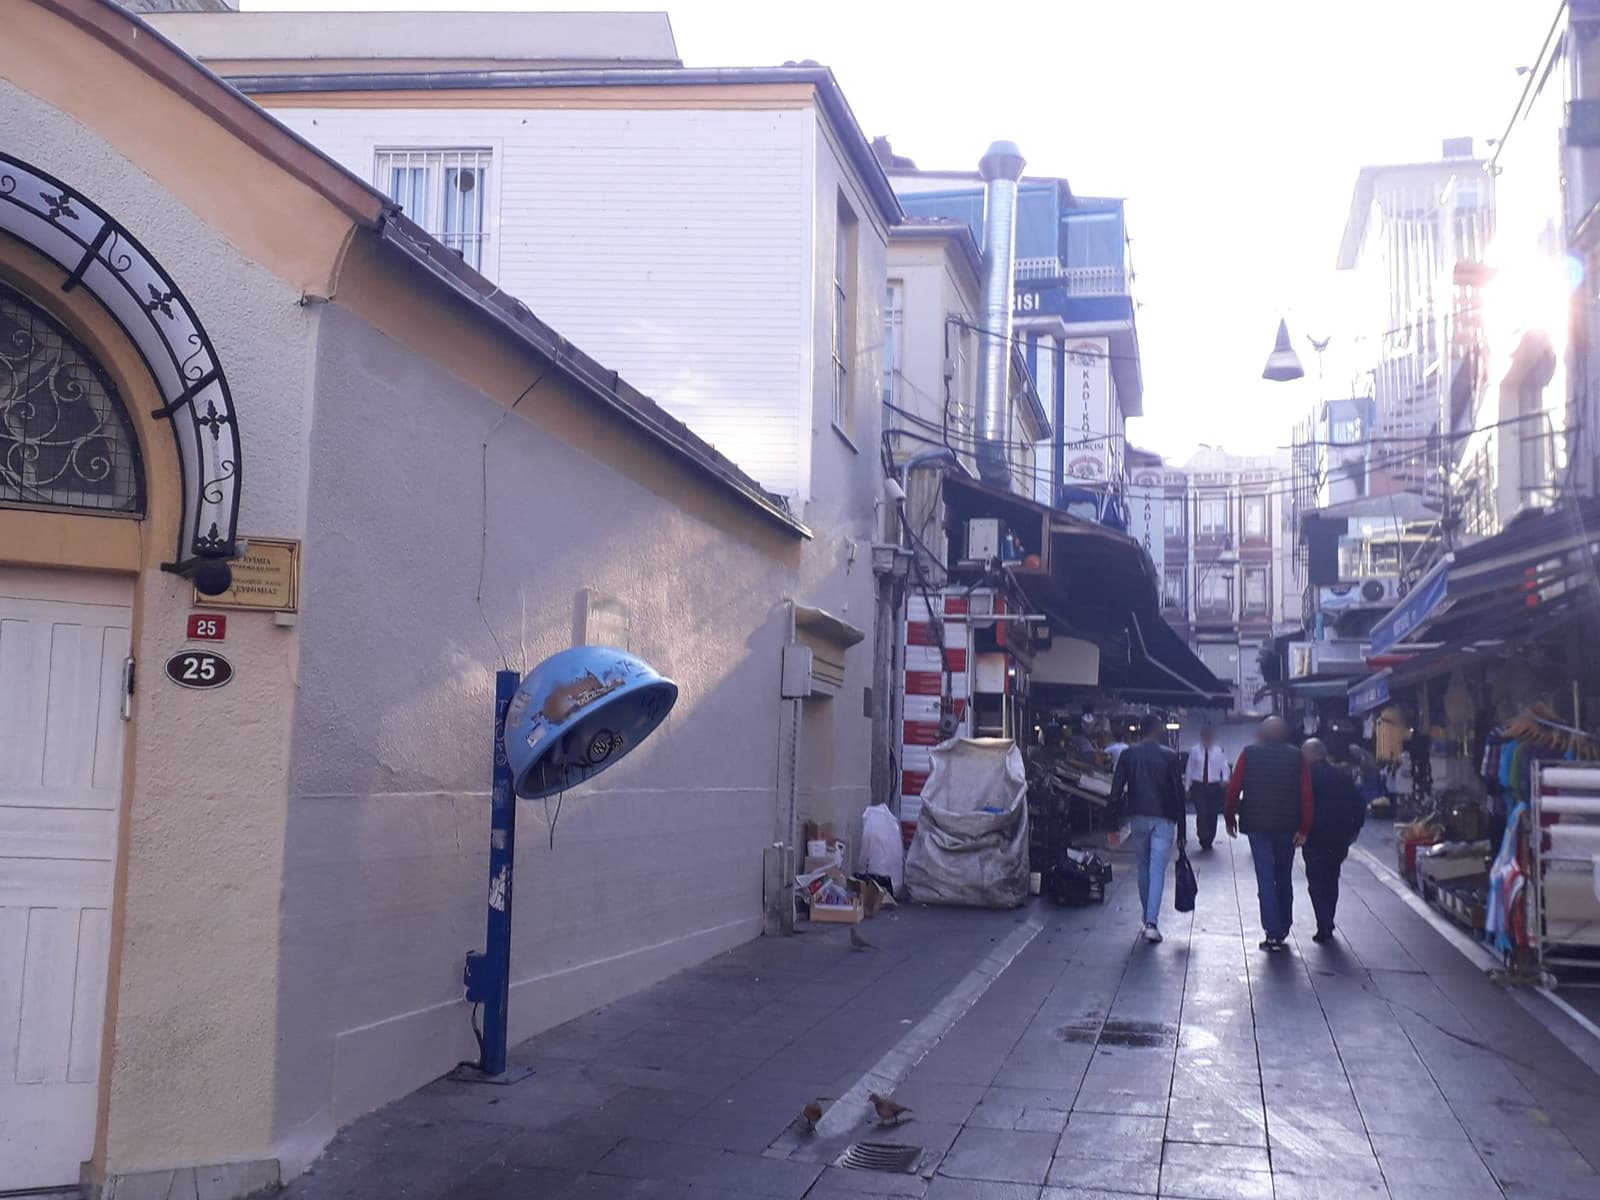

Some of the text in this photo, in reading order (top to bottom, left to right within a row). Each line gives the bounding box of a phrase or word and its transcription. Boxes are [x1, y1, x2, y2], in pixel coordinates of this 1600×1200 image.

[1013, 292, 1040, 311] ISI
[197, 620, 217, 635] 25
[182, 657, 216, 680] 25
